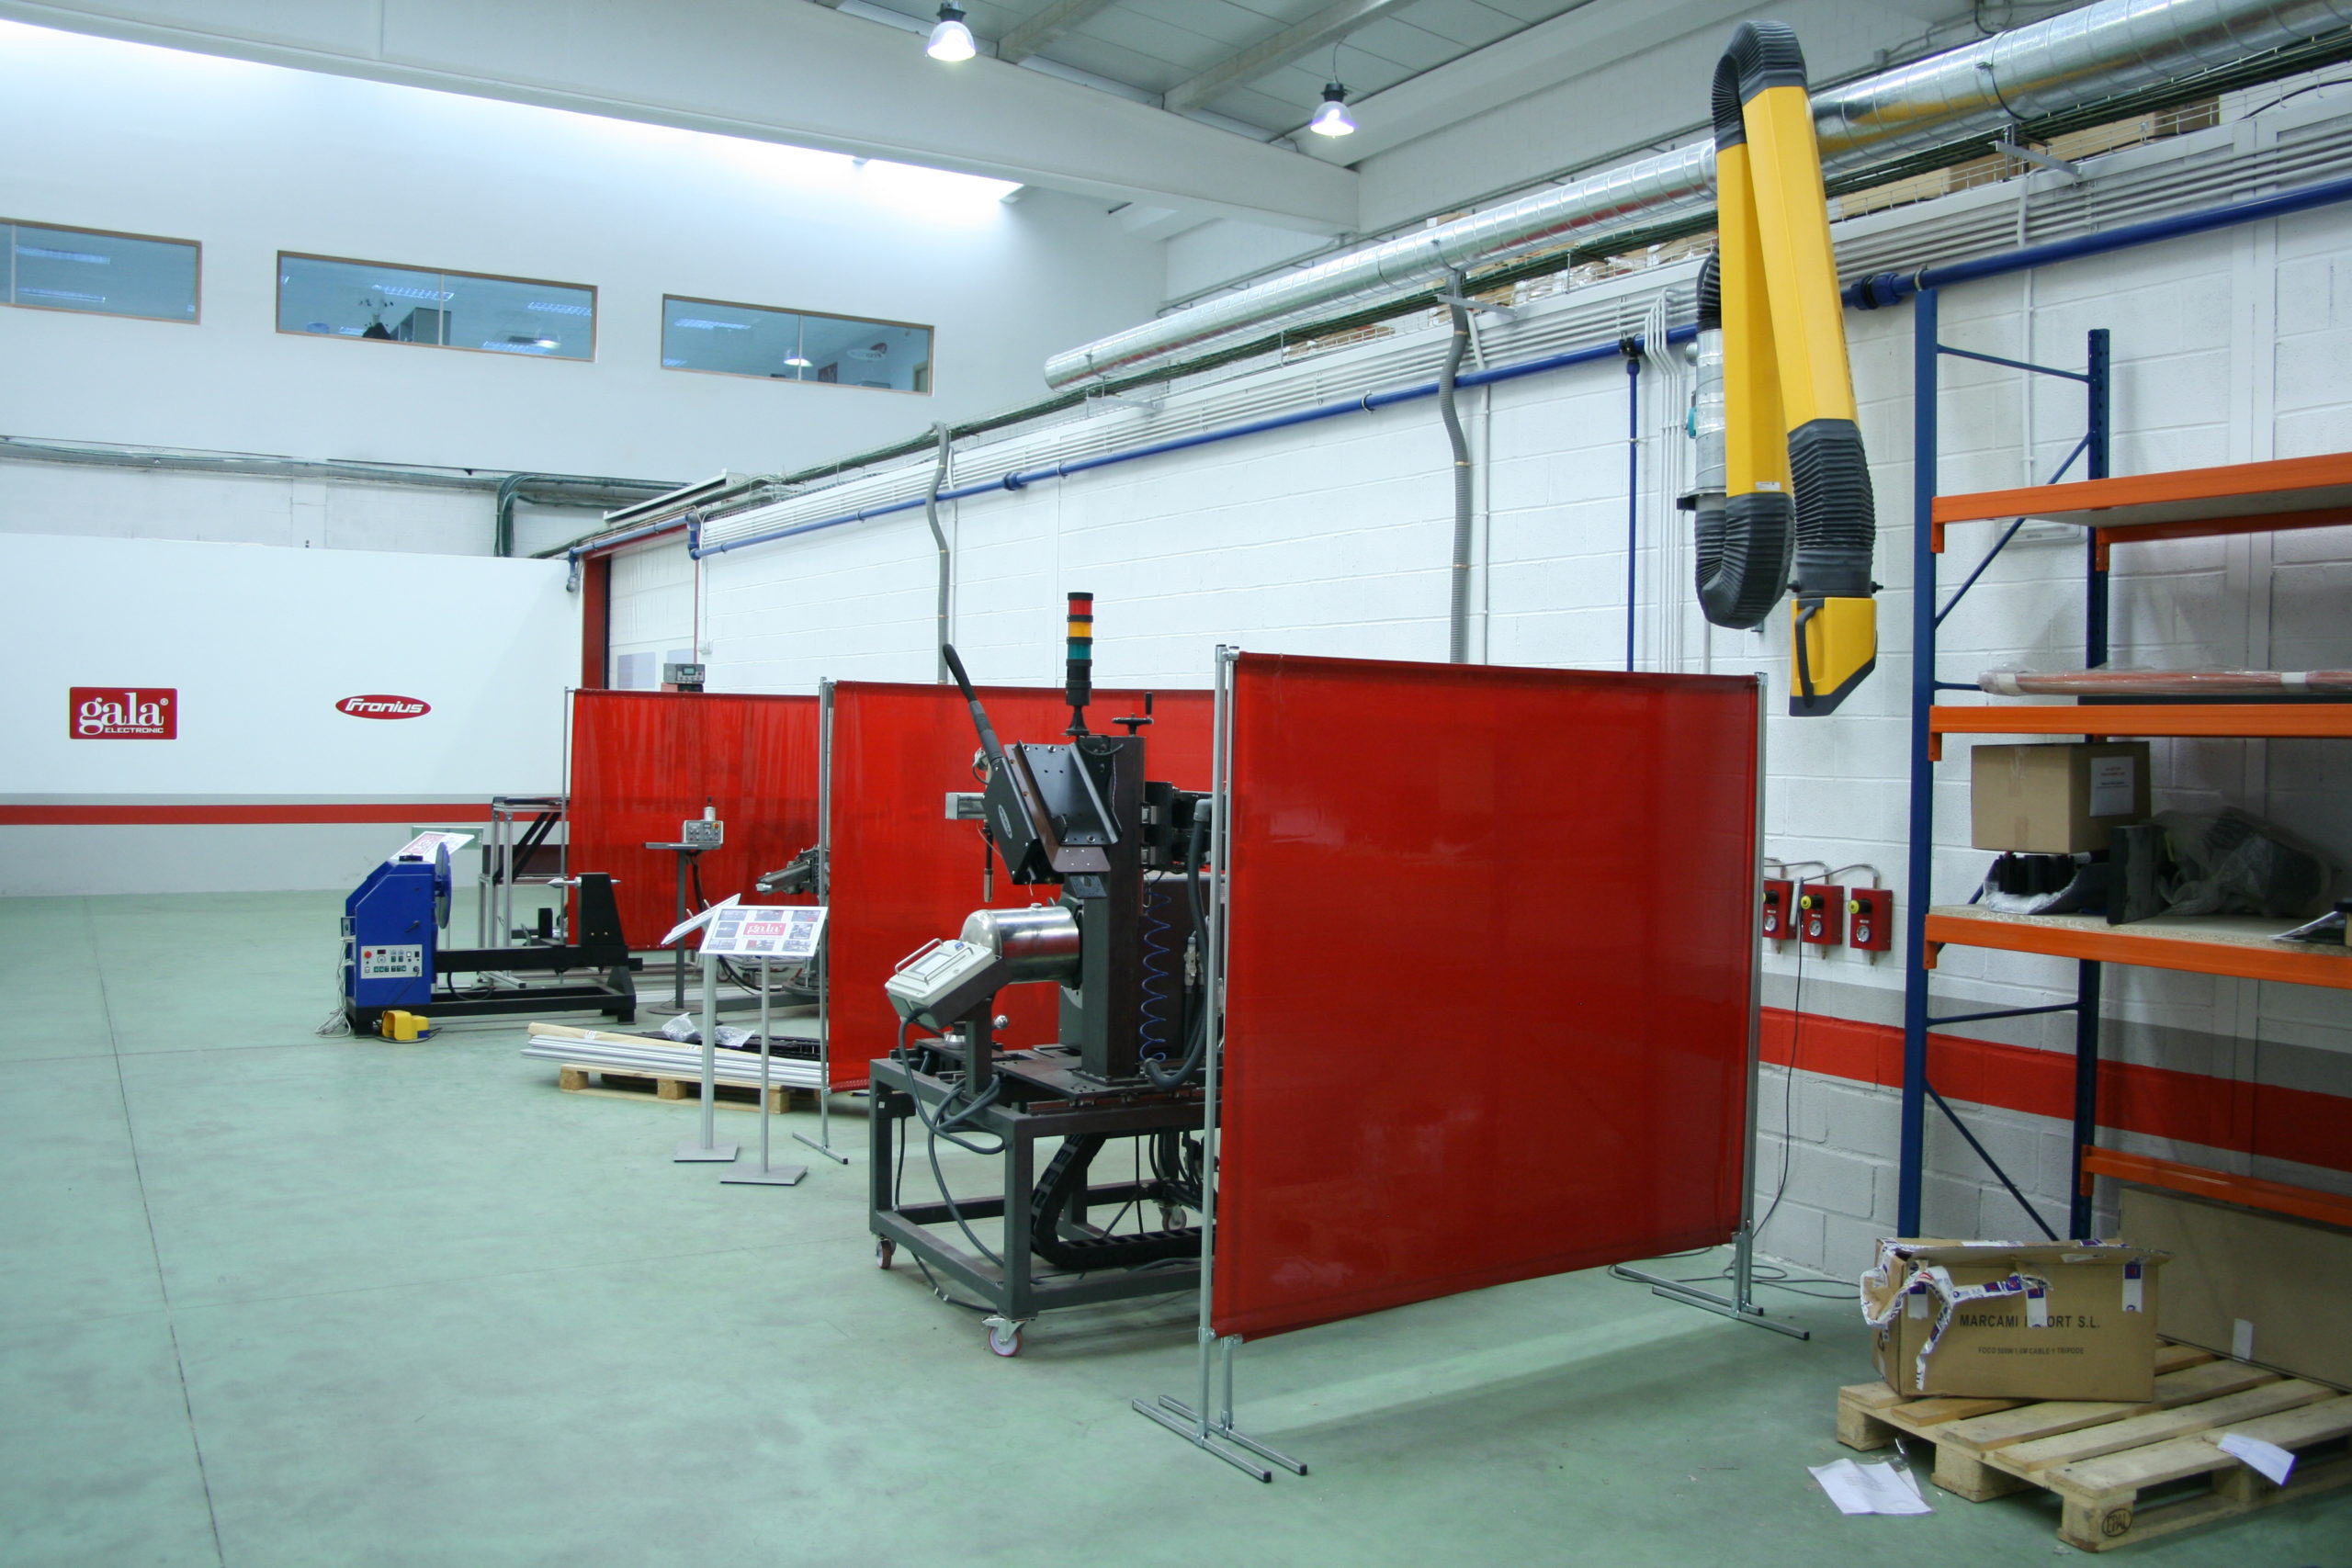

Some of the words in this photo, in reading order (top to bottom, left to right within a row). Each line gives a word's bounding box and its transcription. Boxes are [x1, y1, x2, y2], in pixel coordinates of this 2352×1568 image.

[345, 698, 424, 713] Fronius
[79, 692, 164, 735] gala
[1959, 1314, 2018, 1327] MARCAMI
[2024, 1315, 2073, 1327] IORT
[2077, 1315, 2101, 1328] S.L.
